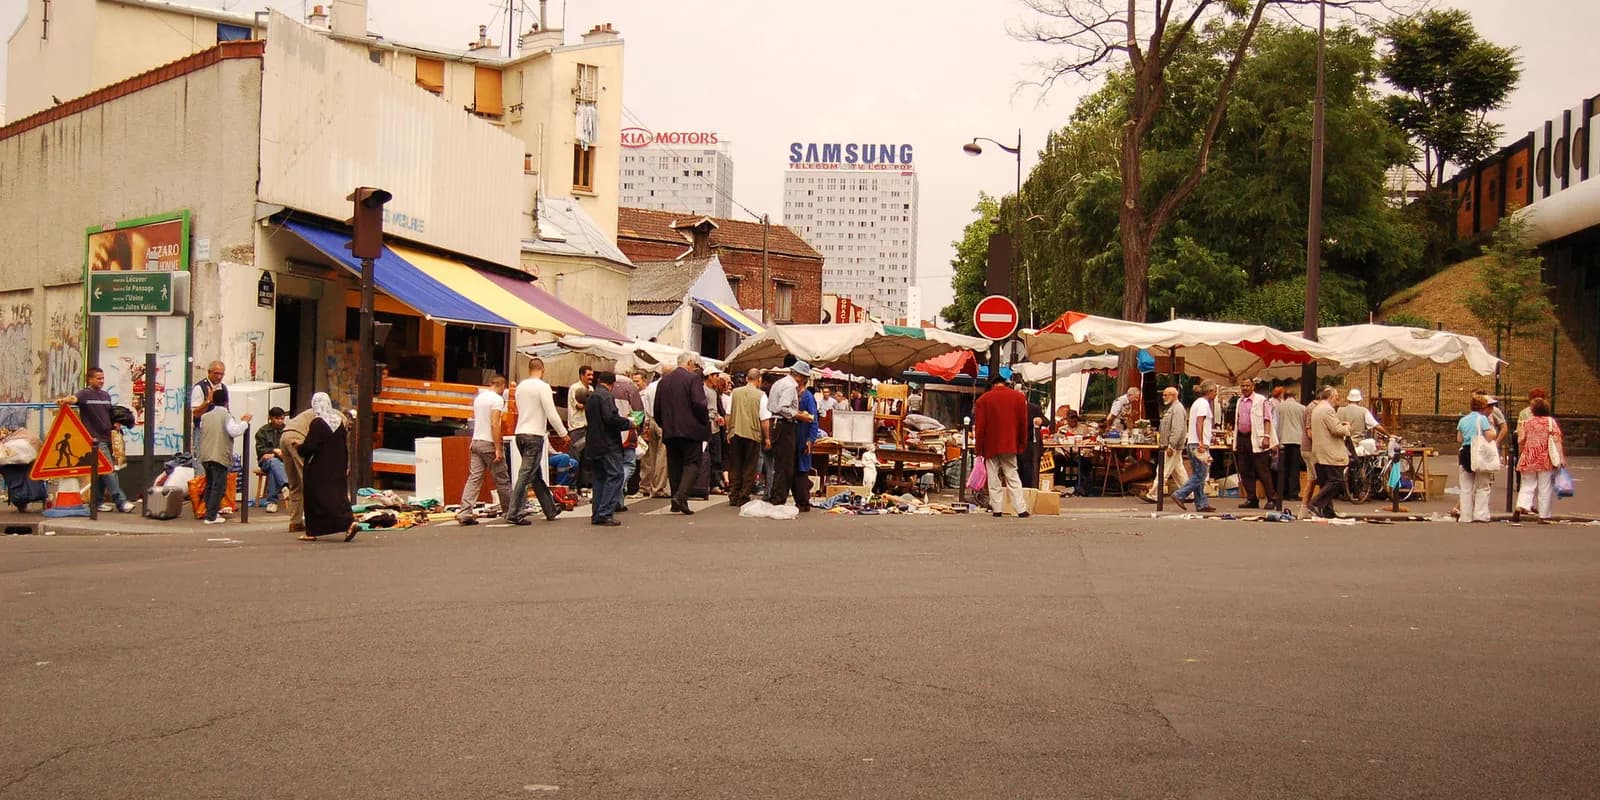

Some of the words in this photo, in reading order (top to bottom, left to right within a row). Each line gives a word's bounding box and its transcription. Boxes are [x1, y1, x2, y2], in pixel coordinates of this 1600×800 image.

[620, 133, 646, 144] KIA
[655, 132, 718, 145] MOTORS
[789, 142, 913, 163] SAMSUNG
[145, 243, 180, 260] AZZARO
